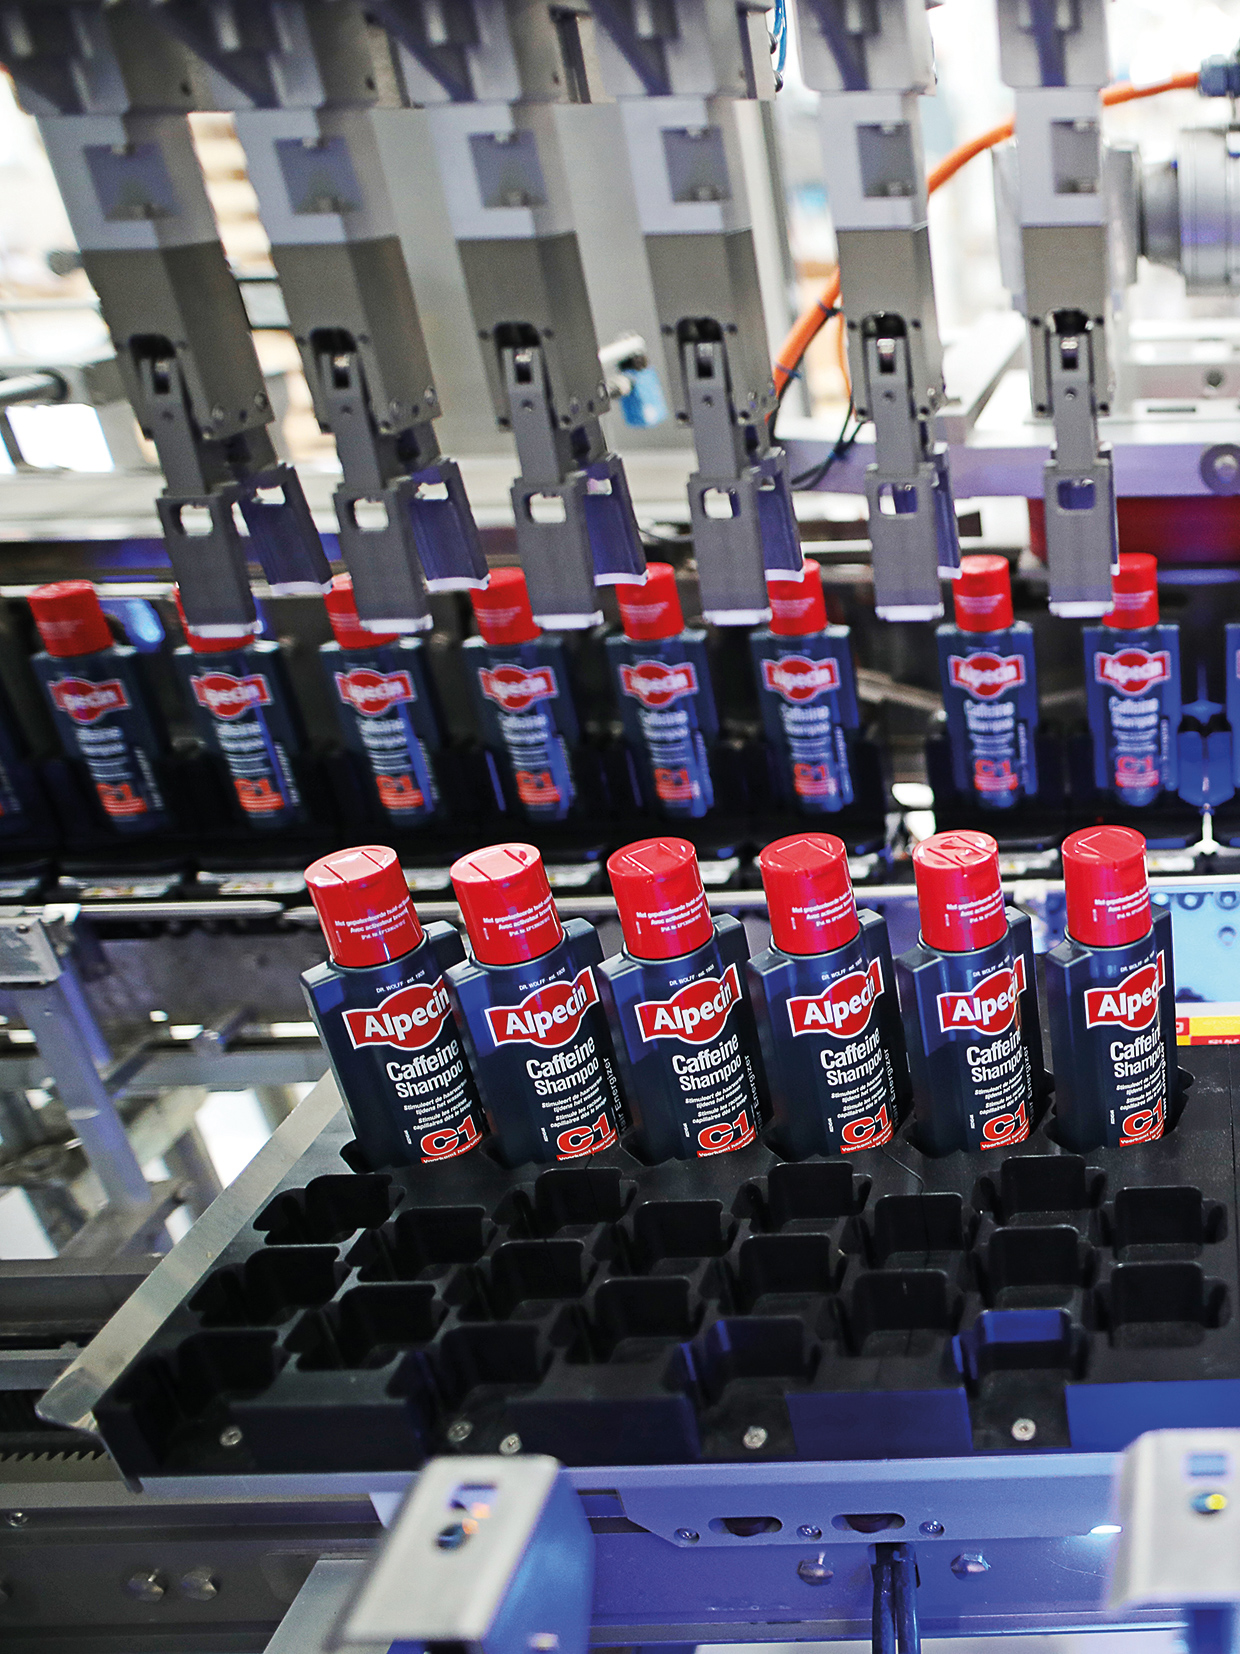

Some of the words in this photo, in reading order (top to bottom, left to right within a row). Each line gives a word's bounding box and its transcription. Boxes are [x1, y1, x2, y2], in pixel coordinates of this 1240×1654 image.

[386, 981, 404, 991] WOLFF
[529, 978, 545, 988] WOLFF
[804, 975, 875, 1029] Alpecin
[1098, 971, 1159, 1020] Alpec
[365, 986, 450, 1041] Alpecin
[506, 984, 588, 1038] Alpecin
[654, 981, 732, 1035] Alpecin
[386, 1039, 459, 1082] Caffeine
[526, 1037, 596, 1079] Caffeine
[672, 1034, 738, 1074] Caffeine
[820, 1027, 880, 1069] Caffeine
[1110, 1025, 1161, 1061] Caffein
[1114, 1047, 1161, 1078] Shampo
[395, 1060, 463, 1098] Shampoo
[534, 1056, 599, 1096] Shampoo
[603, 1058, 622, 1111] Energizer
[679, 1054, 742, 1091] Shampoo
[745, 1055, 759, 1108] Energizer
[826, 1048, 883, 1086] Shampoo
[437, 1100, 446, 1109] het
[574, 1098, 583, 1107] het
[983, 1100, 1027, 1141] C1
[1122, 1097, 1162, 1136] C1
[420, 1114, 478, 1156] C1
[557, 1112, 611, 1154] C1
[697, 1110, 750, 1150] C1
[841, 1103, 888, 1144] C1
